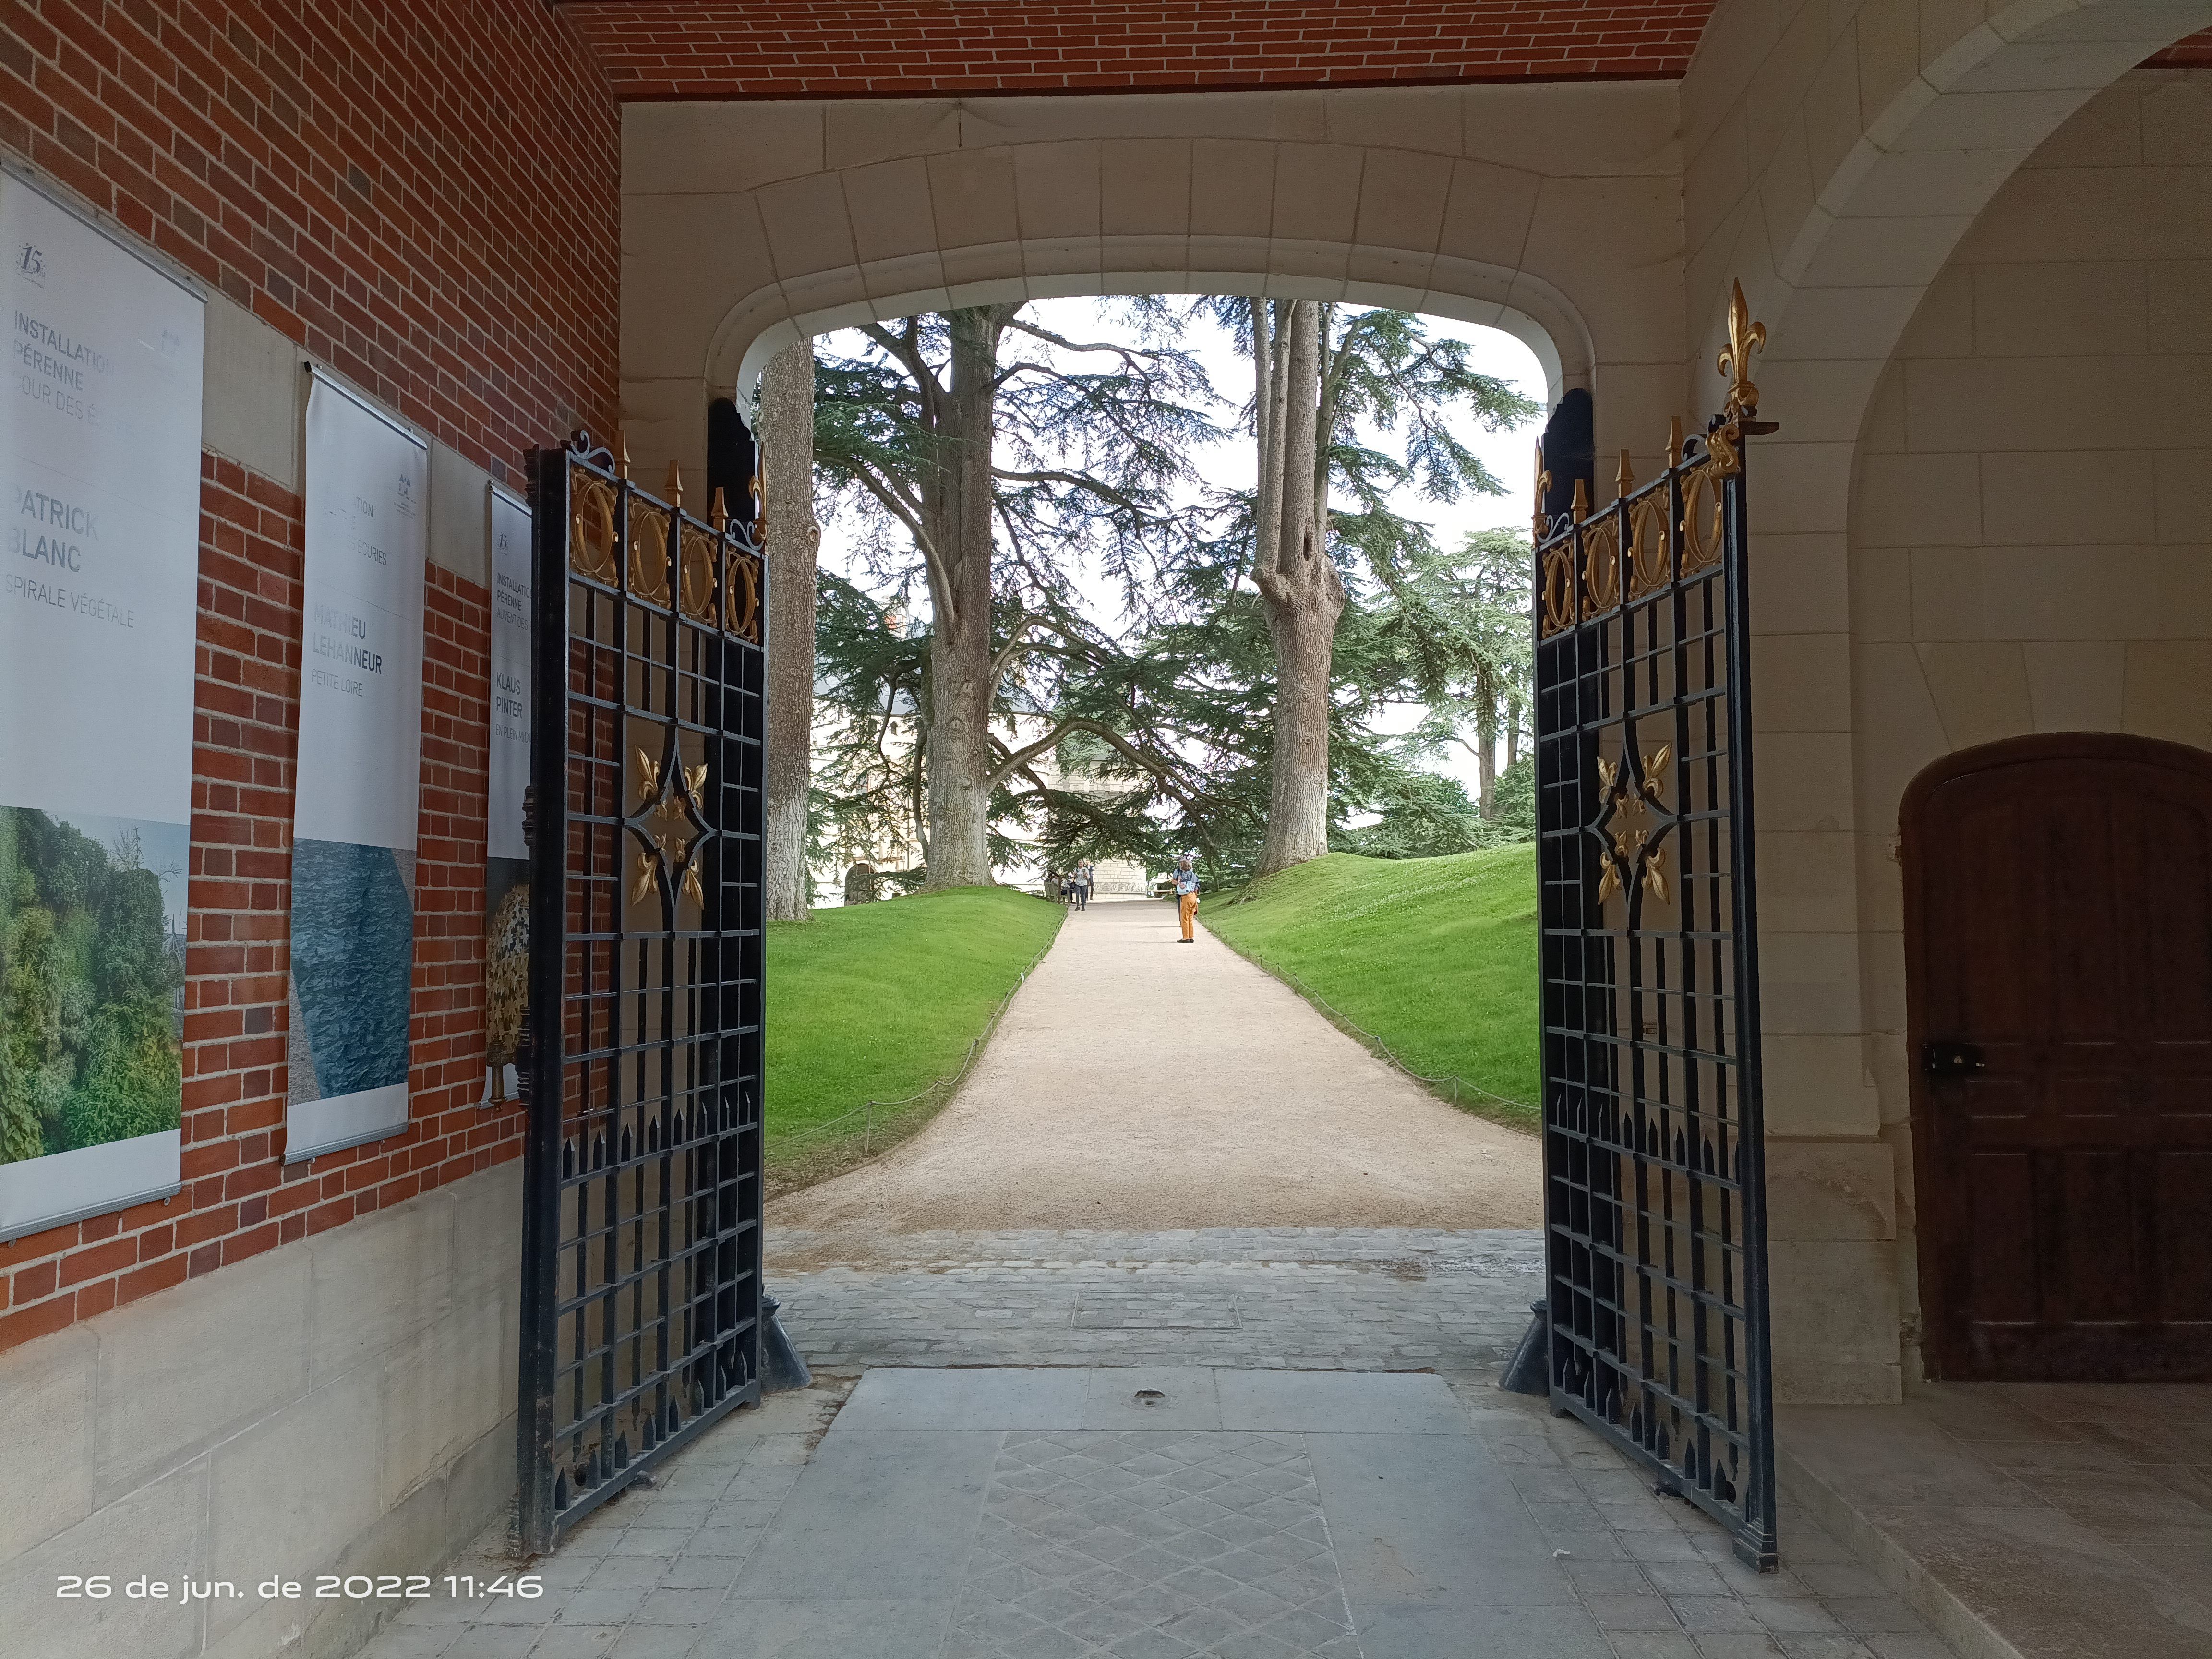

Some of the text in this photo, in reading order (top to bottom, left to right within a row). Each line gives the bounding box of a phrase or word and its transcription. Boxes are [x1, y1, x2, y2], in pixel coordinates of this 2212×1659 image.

[56, 391, 83, 419] DES
[497, 572, 531, 598] INSTALLATIO
[5, 574, 134, 629] SPIRALE VÉGÉTALE
[313, 632, 382, 675] LEHANNEUR
[312, 668, 362, 697] PETITE LOIRE
[496, 672, 521, 695] KLAUS
[496, 696, 522, 719] PINTER
[496, 724, 503, 736] EN
